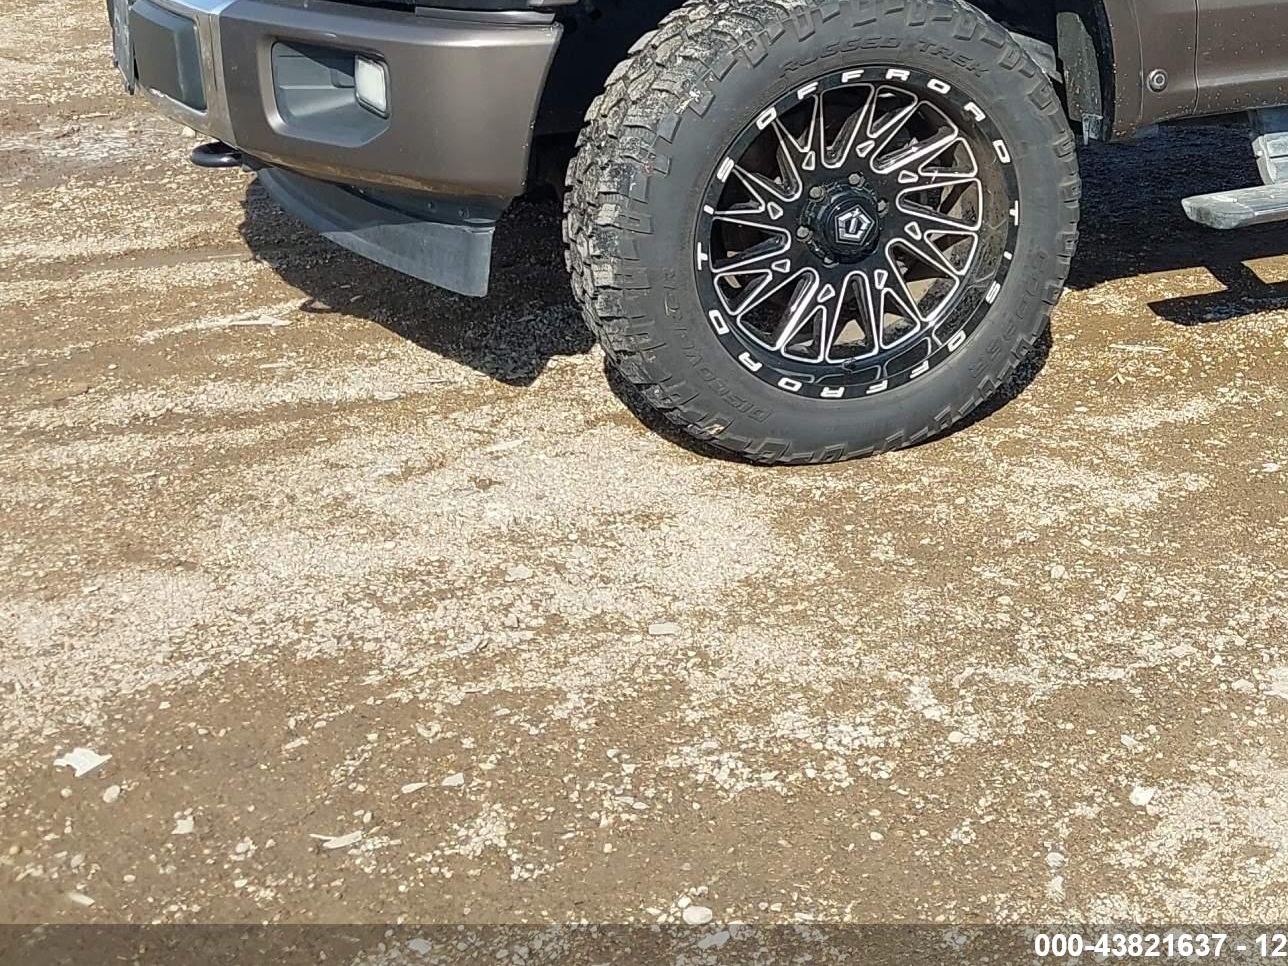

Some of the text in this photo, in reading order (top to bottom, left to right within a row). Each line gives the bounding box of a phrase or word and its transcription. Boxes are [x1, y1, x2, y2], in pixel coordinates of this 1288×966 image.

[918, 40, 988, 77] TREK
[755, 68, 1011, 164] OFFROAD
[697, 156, 735, 271] TIS
[985, 199, 1019, 304] TIS
[708, 309, 967, 398] OFFROAD
